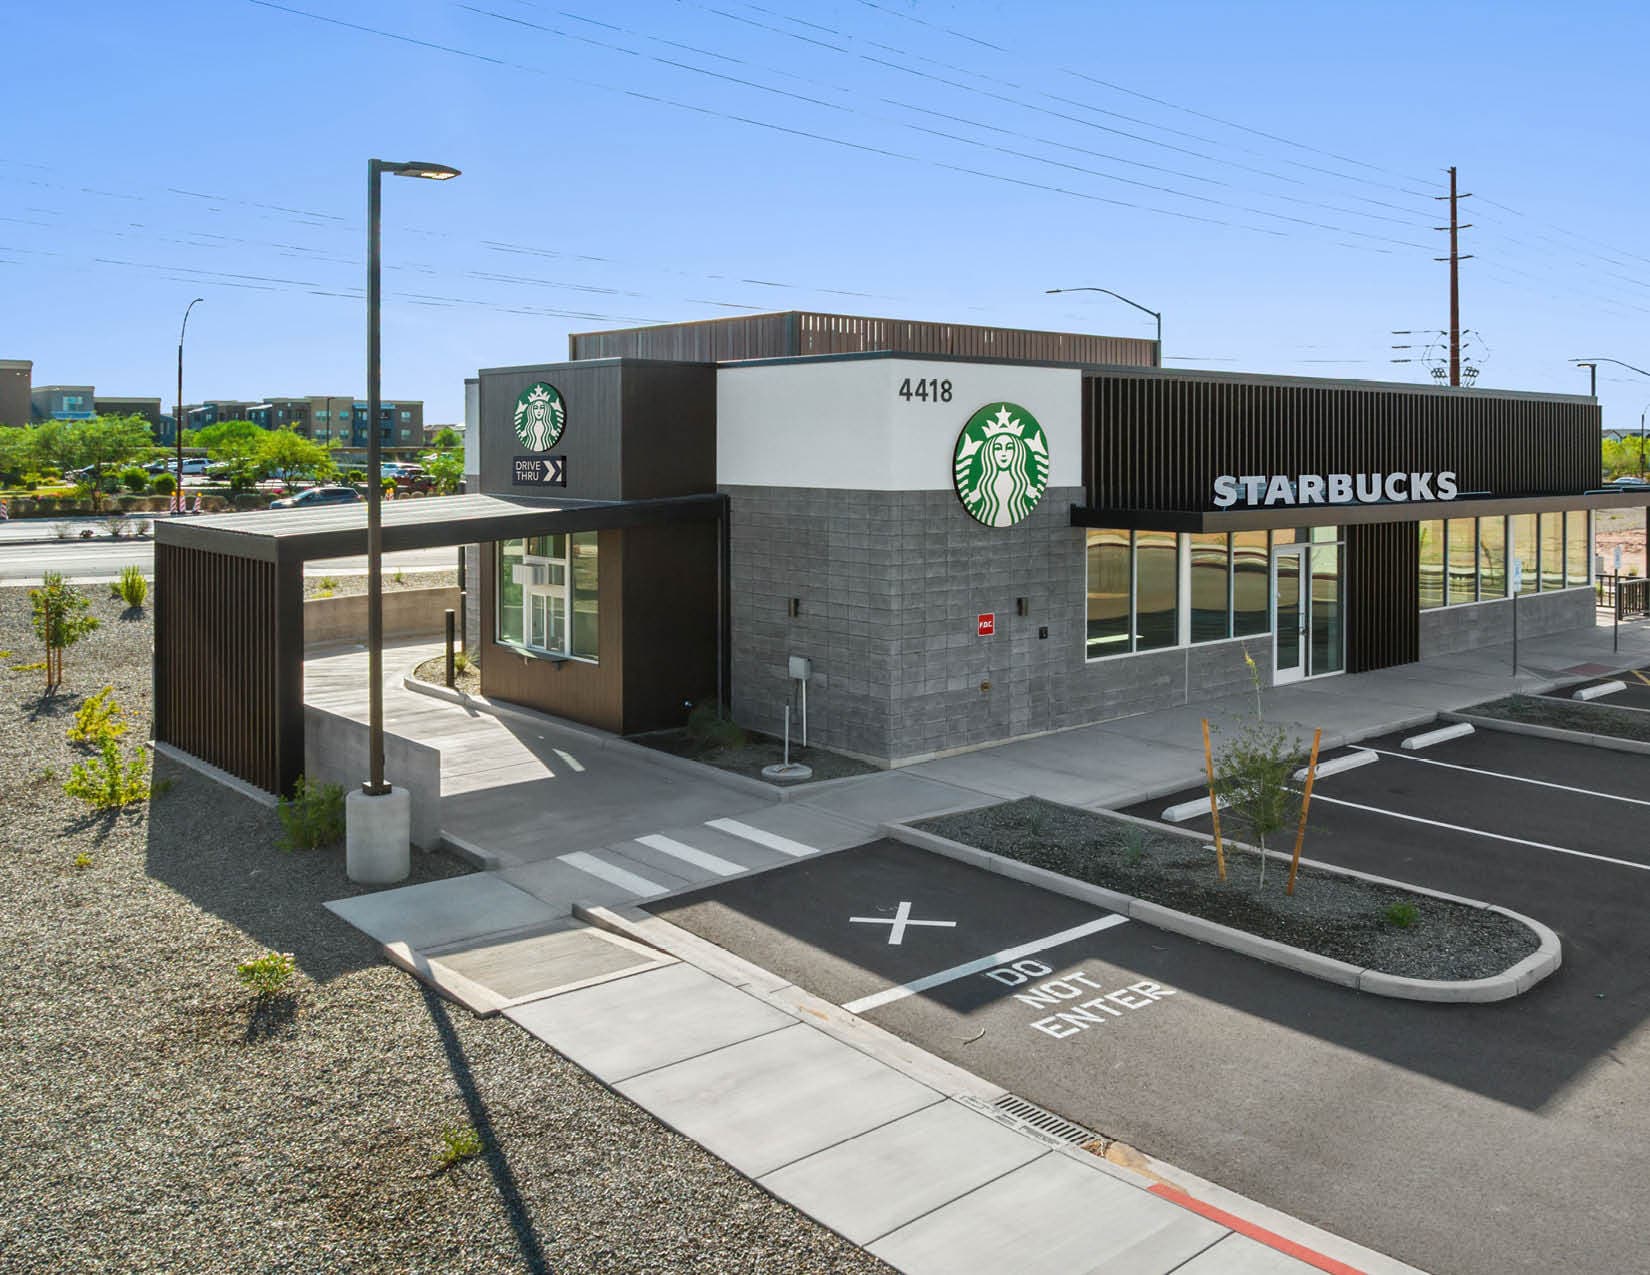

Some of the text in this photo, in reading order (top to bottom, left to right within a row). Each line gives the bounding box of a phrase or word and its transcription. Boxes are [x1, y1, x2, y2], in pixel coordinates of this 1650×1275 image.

[899, 378, 952, 402] 4418
[515, 461, 541, 470] DRIVE
[516, 471, 539, 480] THRU
[1213, 471, 1458, 506] STARBUCKS
[985, 960, 1052, 986] DO
[1013, 971, 1101, 1010] NOT
[1029, 981, 1176, 1039] ENTER
